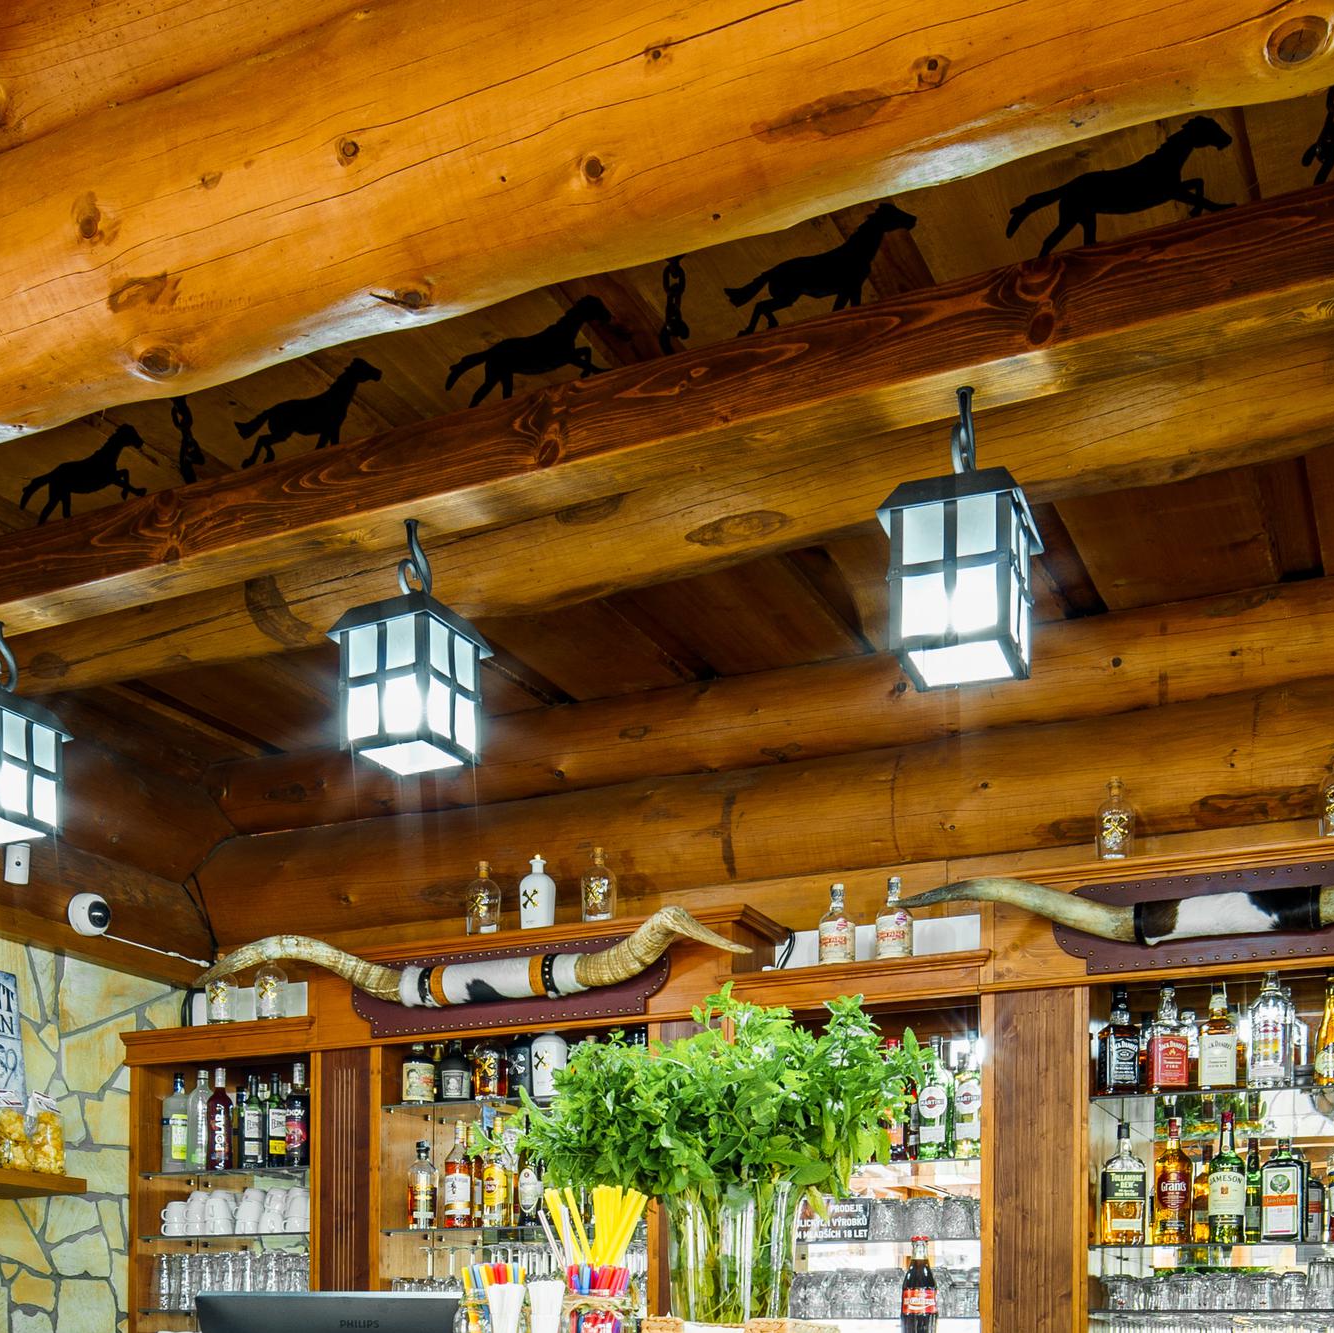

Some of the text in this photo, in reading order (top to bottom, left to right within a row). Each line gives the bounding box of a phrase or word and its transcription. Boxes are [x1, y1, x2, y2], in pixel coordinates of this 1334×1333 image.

[1110, 1172, 1143, 1182] TULLAMORE
[1209, 1173, 1242, 1185] JAMESON
[1161, 1181, 1186, 1192] Grant's
[830, 1203, 864, 1212] PRODEJE
[832, 1215, 868, 1227] VÝROBKŮ
[844, 1230, 853, 1239] 18
[854, 1229, 869, 1239] LET
[339, 1319, 380, 1329] PHILIPS
